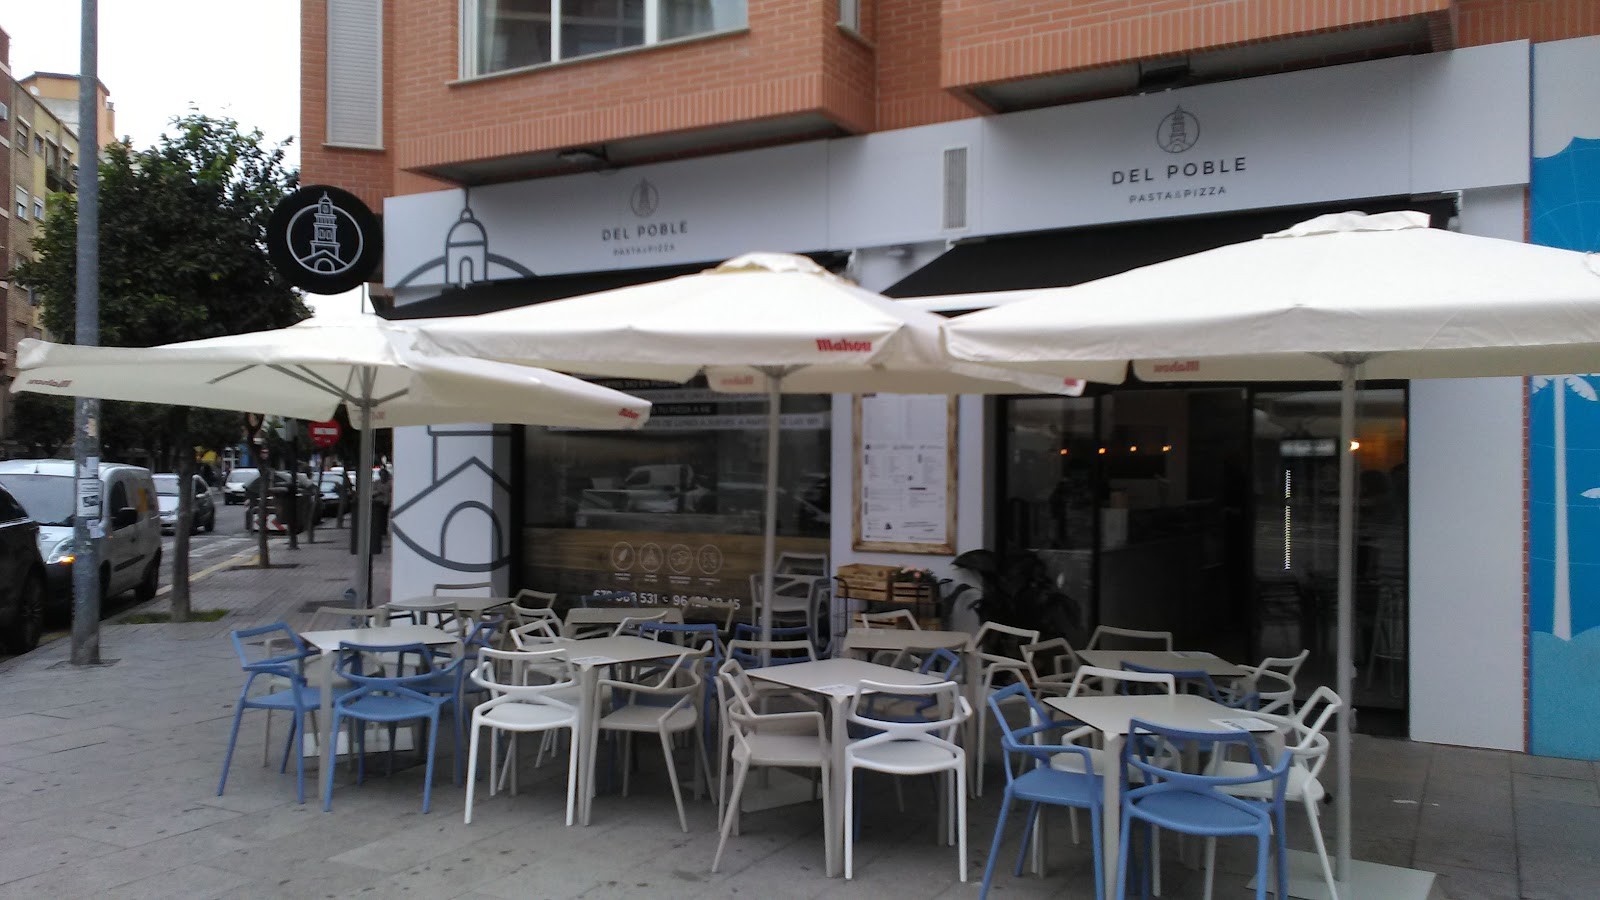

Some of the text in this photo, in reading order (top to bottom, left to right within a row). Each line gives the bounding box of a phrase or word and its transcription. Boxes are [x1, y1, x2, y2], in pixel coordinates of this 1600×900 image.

[1112, 157, 1247, 185] DEL POBLE
[602, 220, 688, 241] DEL POBLE
[816, 338, 872, 352] Mahou
[640, 592, 658, 604] 531
[673, 594, 688, 606] 96
